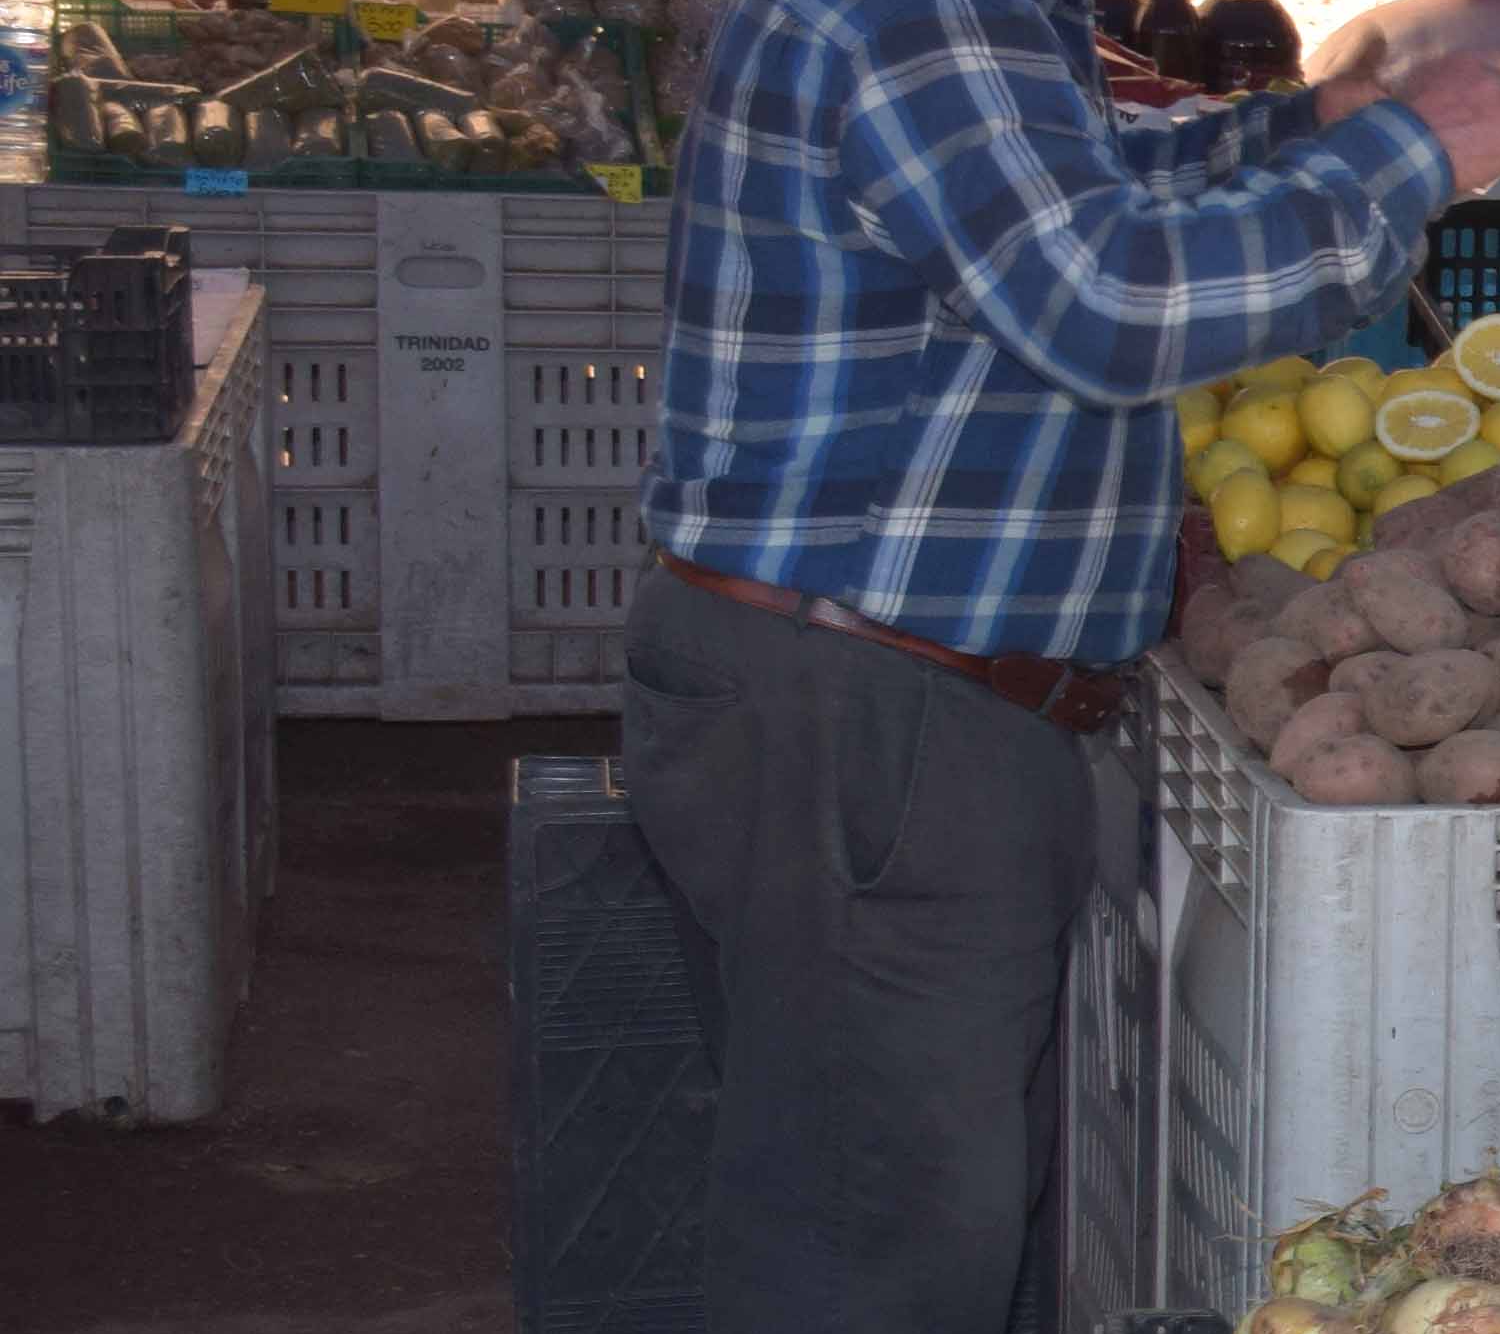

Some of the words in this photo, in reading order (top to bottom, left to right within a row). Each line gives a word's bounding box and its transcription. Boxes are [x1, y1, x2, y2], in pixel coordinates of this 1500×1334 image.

[0, 77, 26, 97] ife
[394, 335, 490, 351] TRINIDAD
[420, 357, 465, 372] 2002
